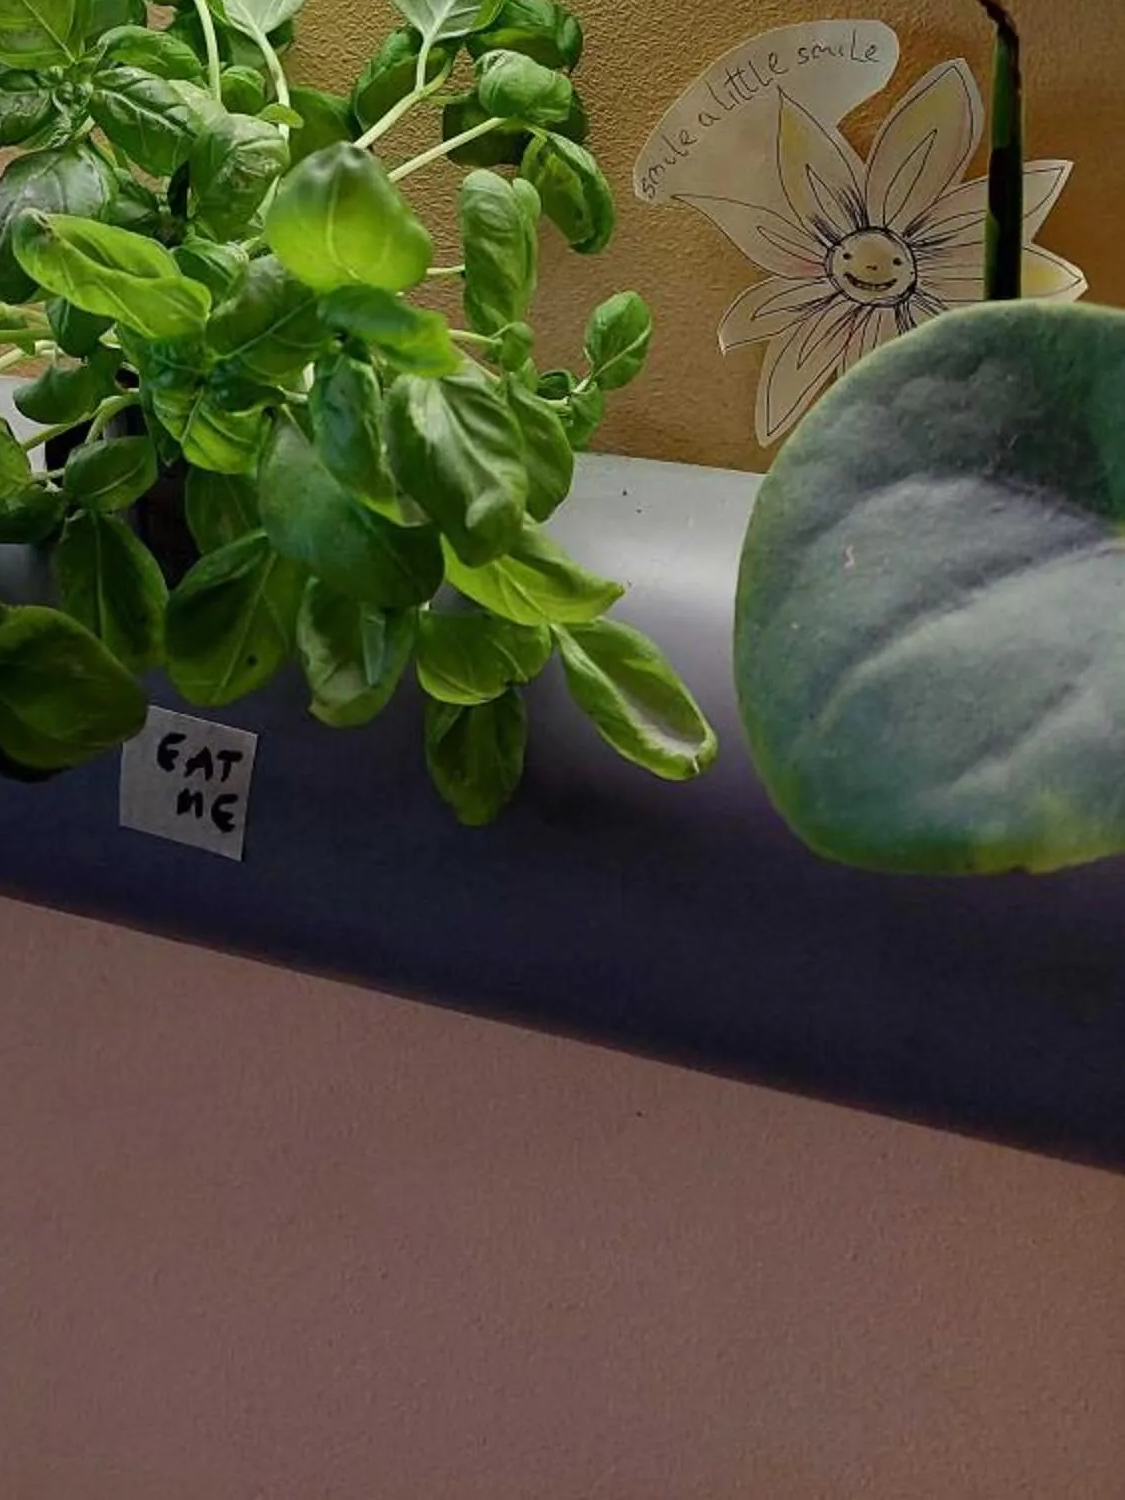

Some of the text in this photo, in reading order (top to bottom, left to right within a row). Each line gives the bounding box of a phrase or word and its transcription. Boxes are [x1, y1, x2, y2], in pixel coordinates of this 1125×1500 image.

[641, 127, 698, 199] smile
[697, 111, 723, 128] a
[156, 732, 244, 782] EAT
[176, 787, 239, 833] ME
